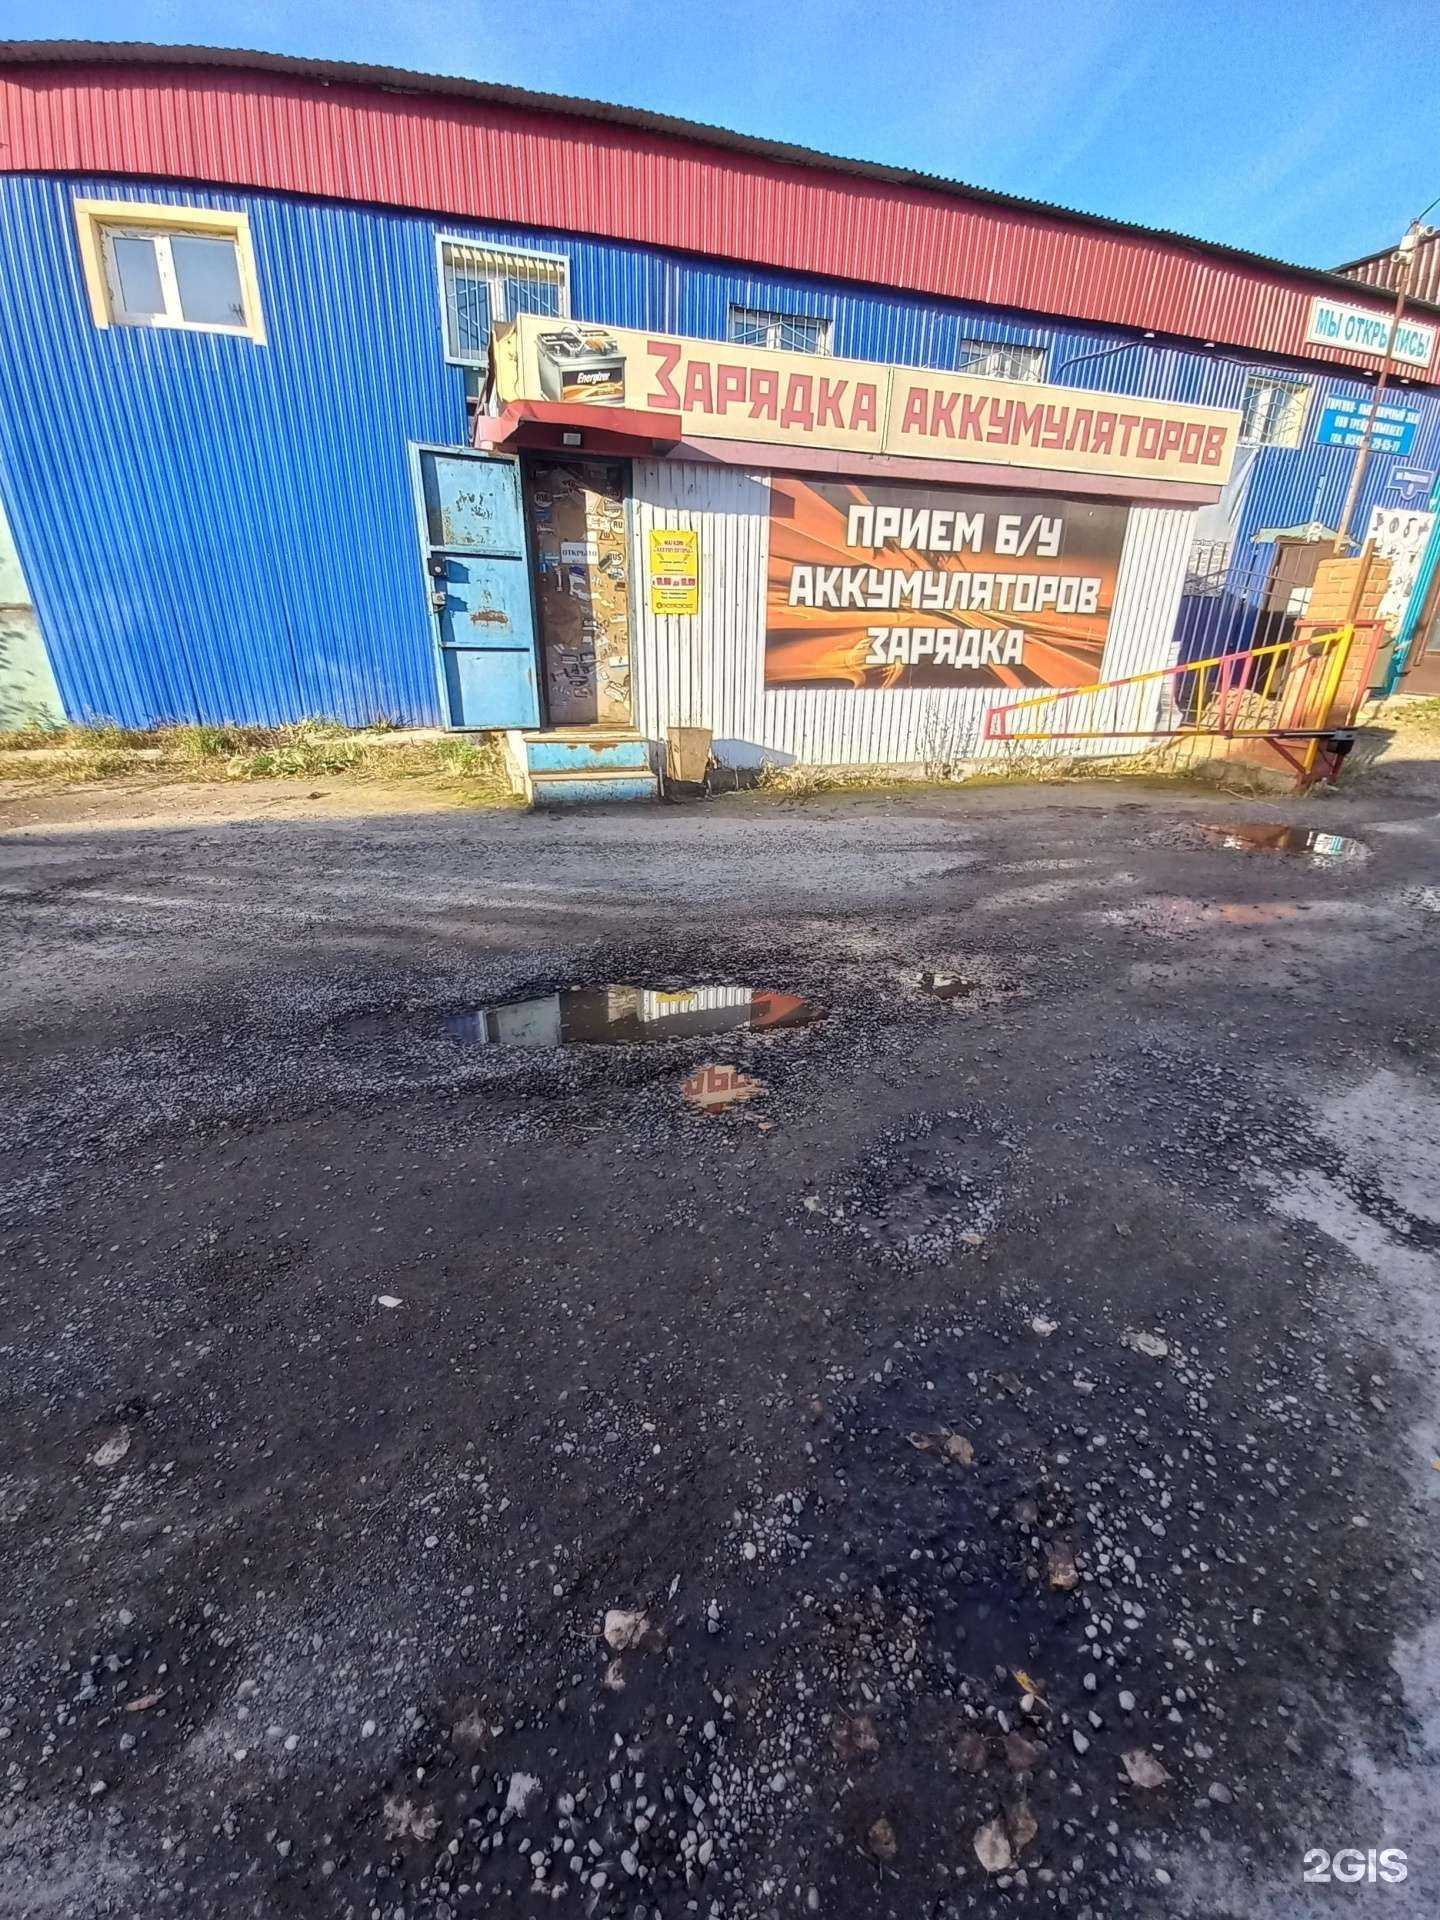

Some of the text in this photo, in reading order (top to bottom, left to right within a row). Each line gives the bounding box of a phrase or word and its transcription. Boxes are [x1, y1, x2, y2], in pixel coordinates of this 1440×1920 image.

[1315, 308, 1343, 338] МЫ
[646, 340, 1229, 467] ЗАРЯДКА АККУМУЛЯТОРОВ
[847, 504, 1063, 558] ПРИЕМ Б/У
[788, 565, 1102, 614] АККУМУЛЯТОРОВ
[865, 626, 1025, 669] ЗАРЯДКА
